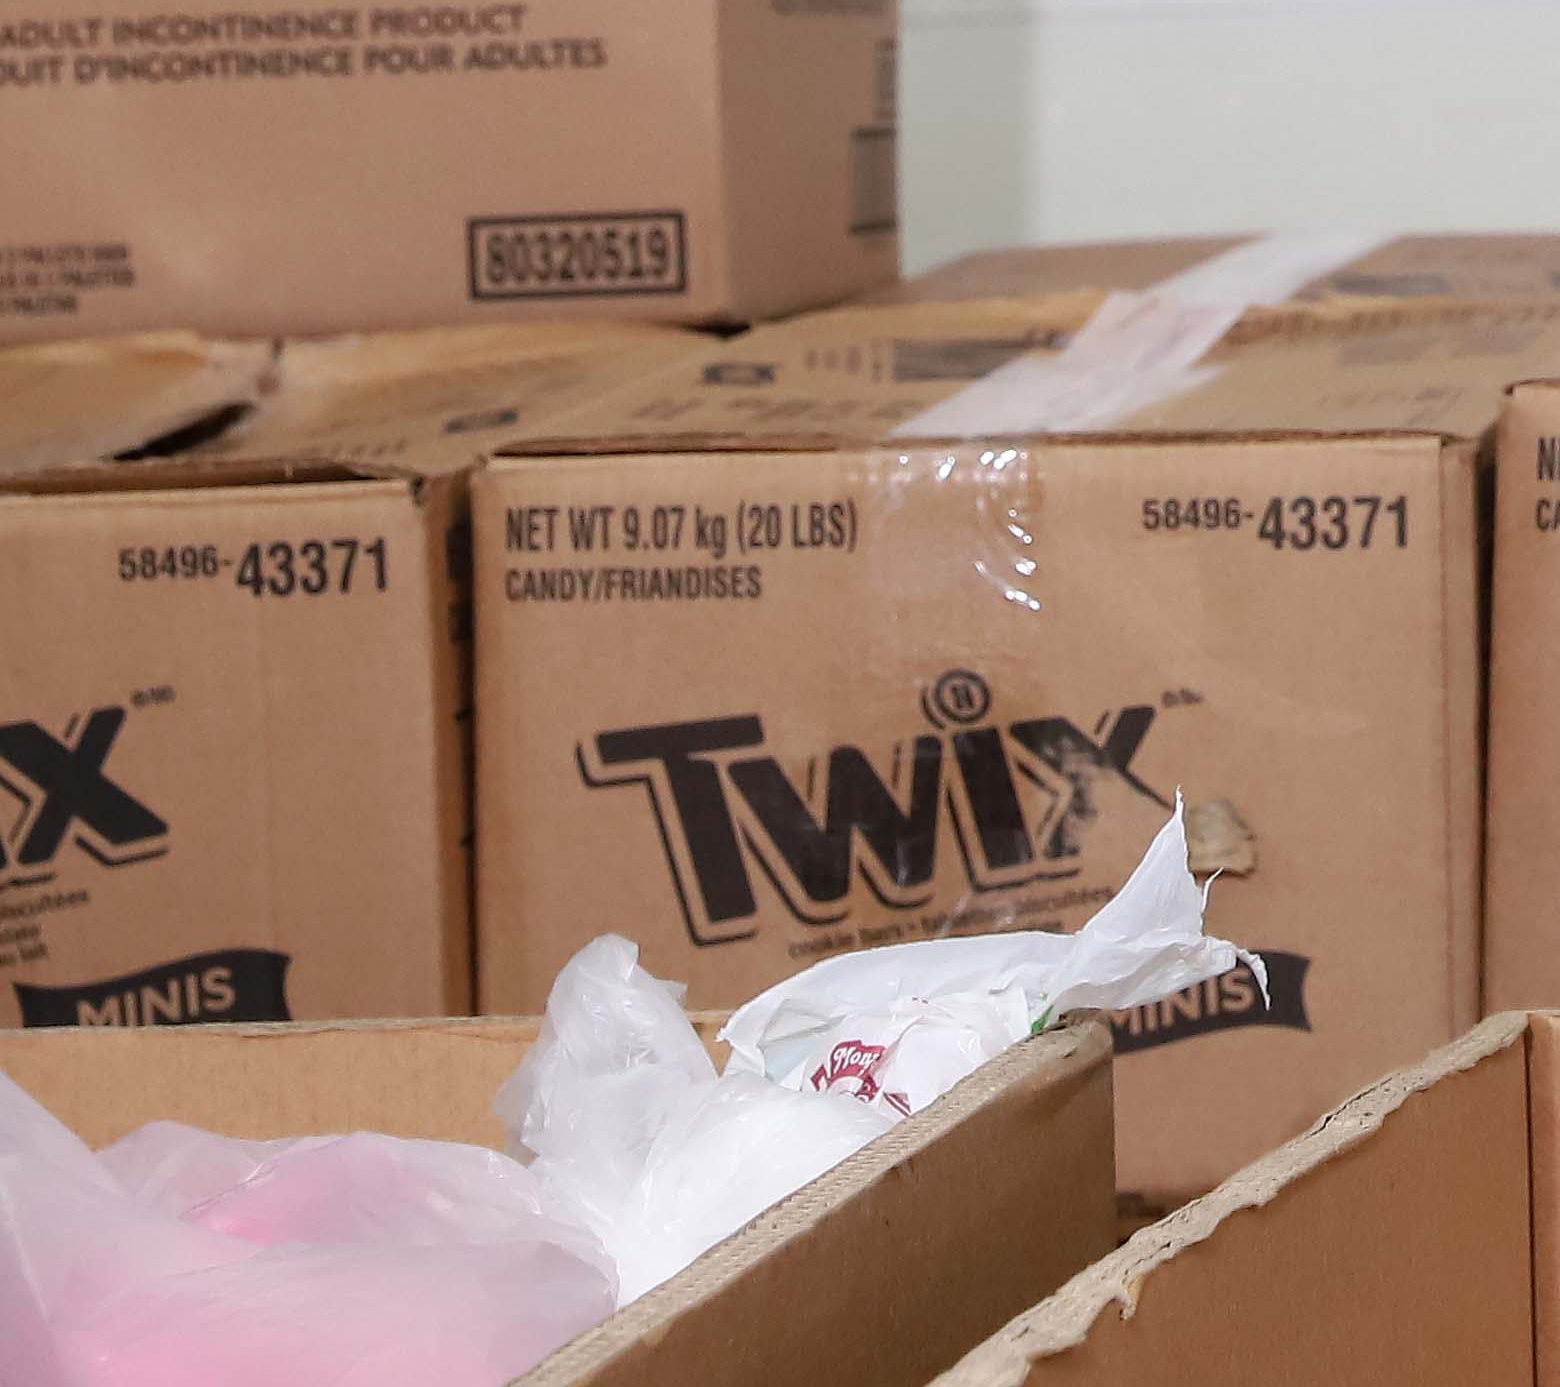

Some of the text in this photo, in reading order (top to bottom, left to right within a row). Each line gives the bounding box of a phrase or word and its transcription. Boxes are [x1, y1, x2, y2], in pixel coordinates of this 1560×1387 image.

[112, 10, 358, 46] INCONTINENCE
[370, 3, 528, 36] PRODUCT
[363, 43, 455, 75] POUR
[464, 36, 609, 70] ADULTES
[486, 229, 670, 284] 80320519
[505, 497, 858, 559] NET WT 9.07 kg (20 LBS)
[1143, 495, 1408, 550] 58496-43371
[504, 564, 764, 602] CANDY/FRIANDISES
[76, 965, 237, 1026] MINIS
